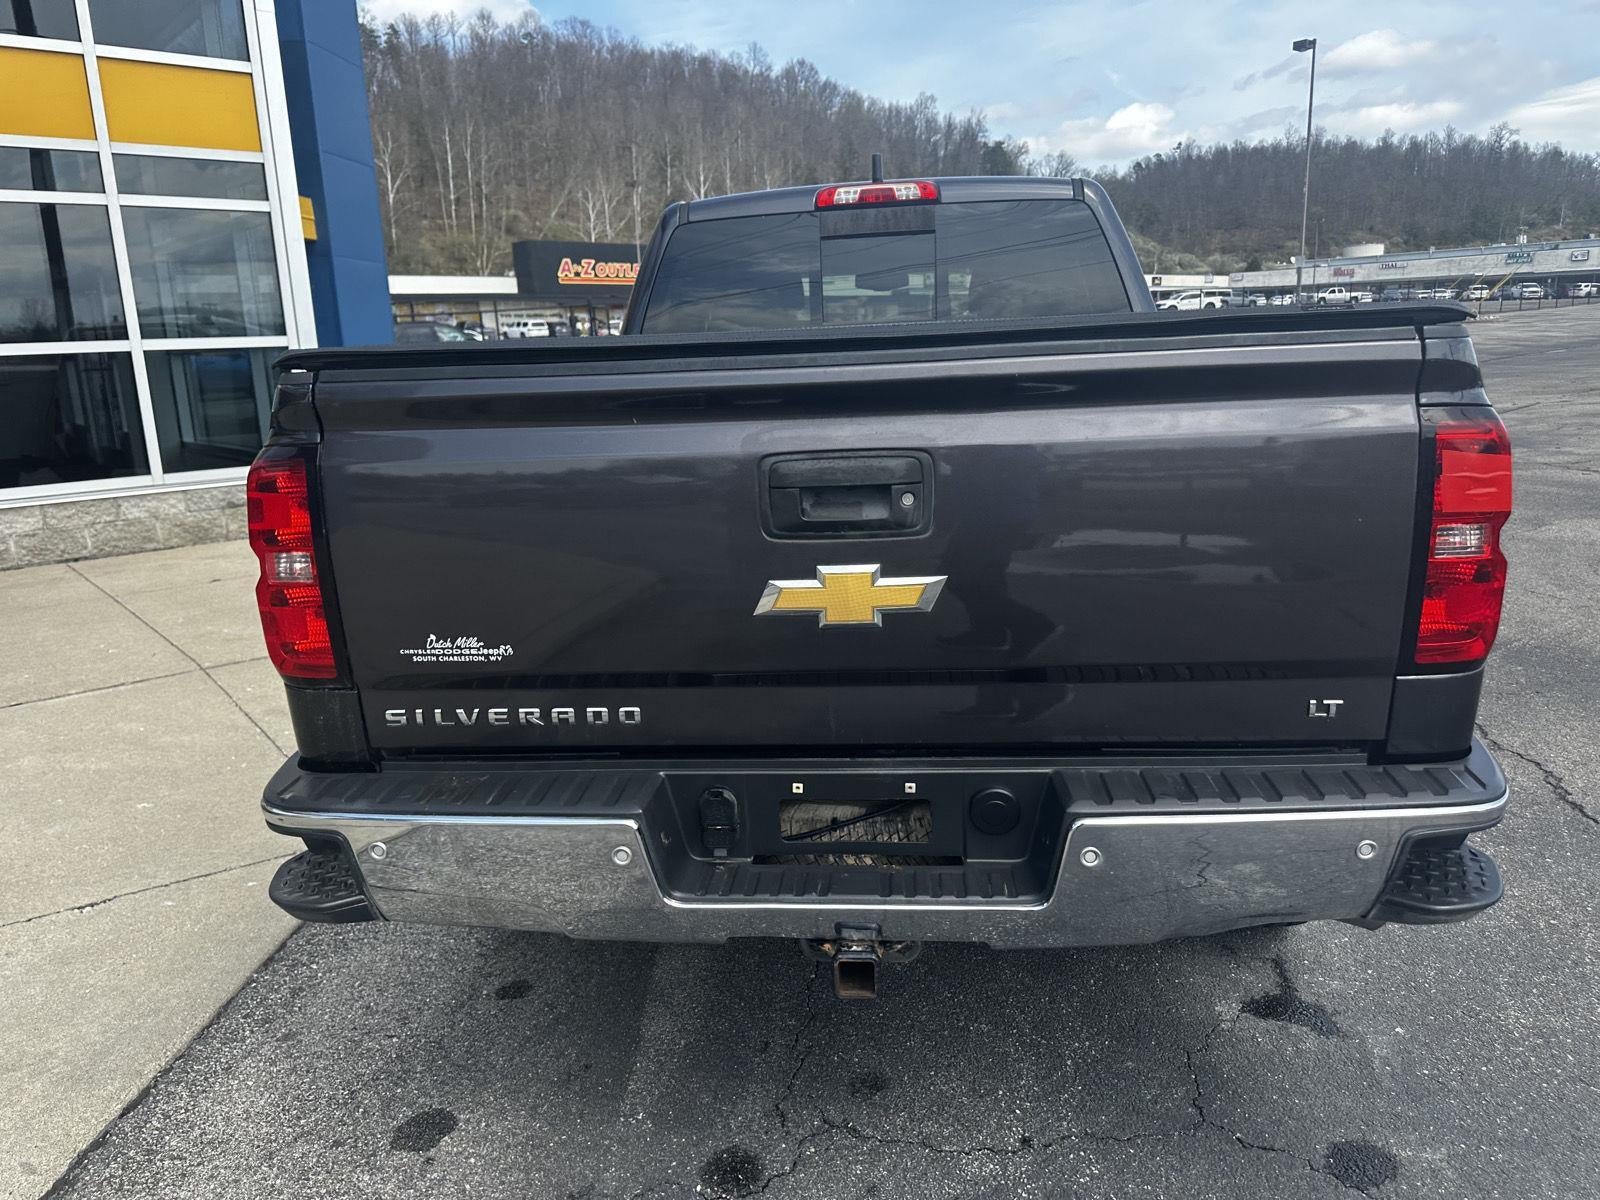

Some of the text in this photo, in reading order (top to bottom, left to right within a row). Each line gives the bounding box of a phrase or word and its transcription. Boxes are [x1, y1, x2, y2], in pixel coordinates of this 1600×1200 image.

[426, 634, 484, 649] Dutch Miller
[385, 706, 642, 727] SILVERADO
[1308, 699, 1344, 718] LT
